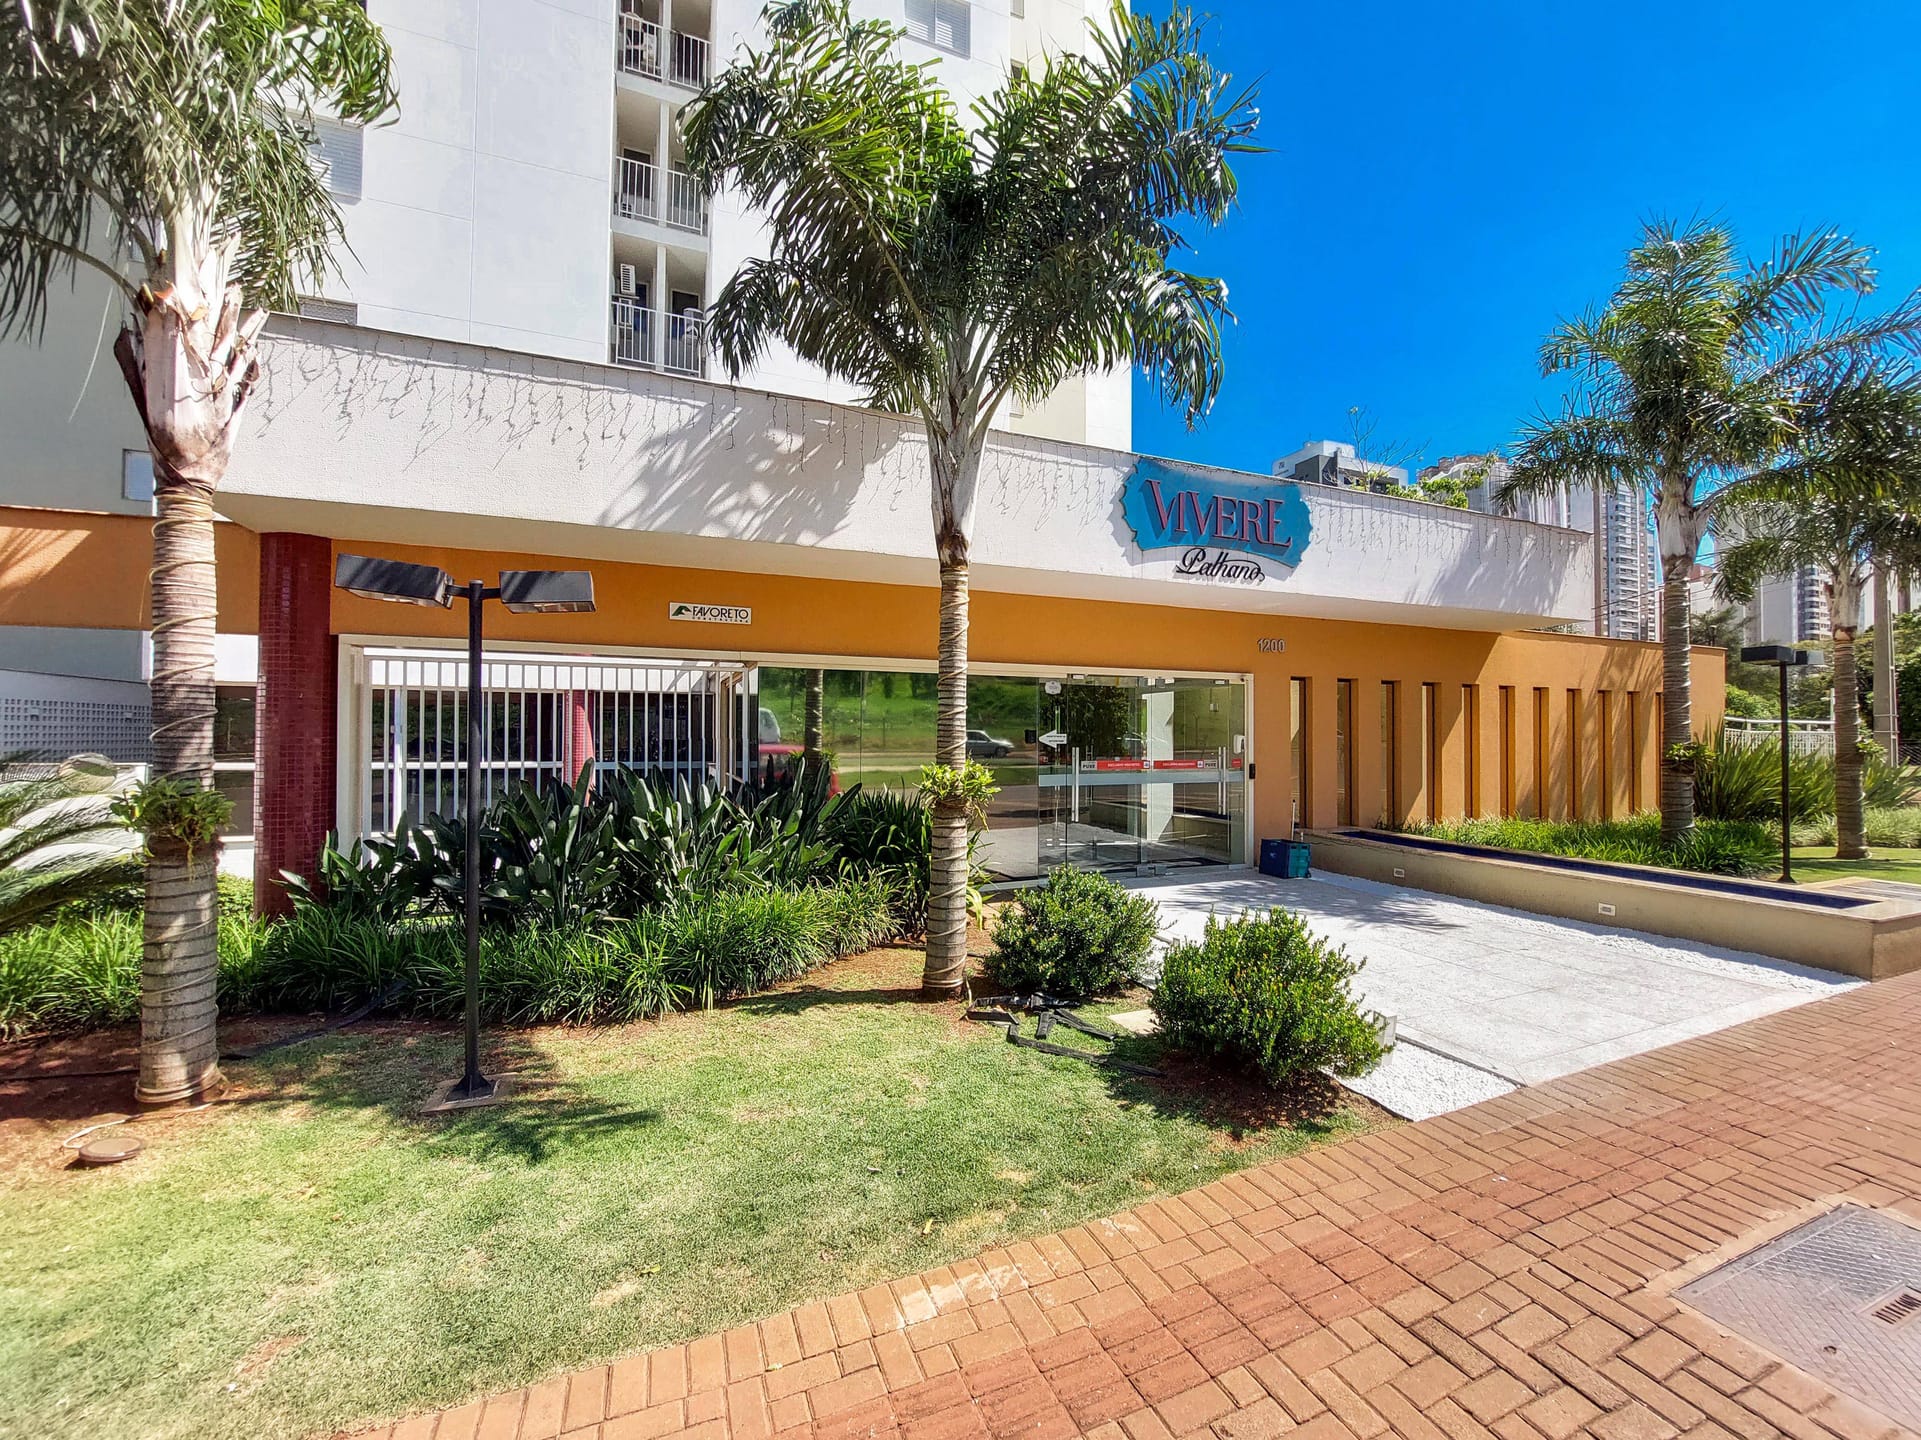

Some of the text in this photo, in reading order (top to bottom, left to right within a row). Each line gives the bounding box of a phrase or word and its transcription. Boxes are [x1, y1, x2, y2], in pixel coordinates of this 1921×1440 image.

[1145, 479, 1292, 548] VIVERE
[692, 605, 749, 619] FAVORETO
[1256, 638, 1286, 653] 1200
